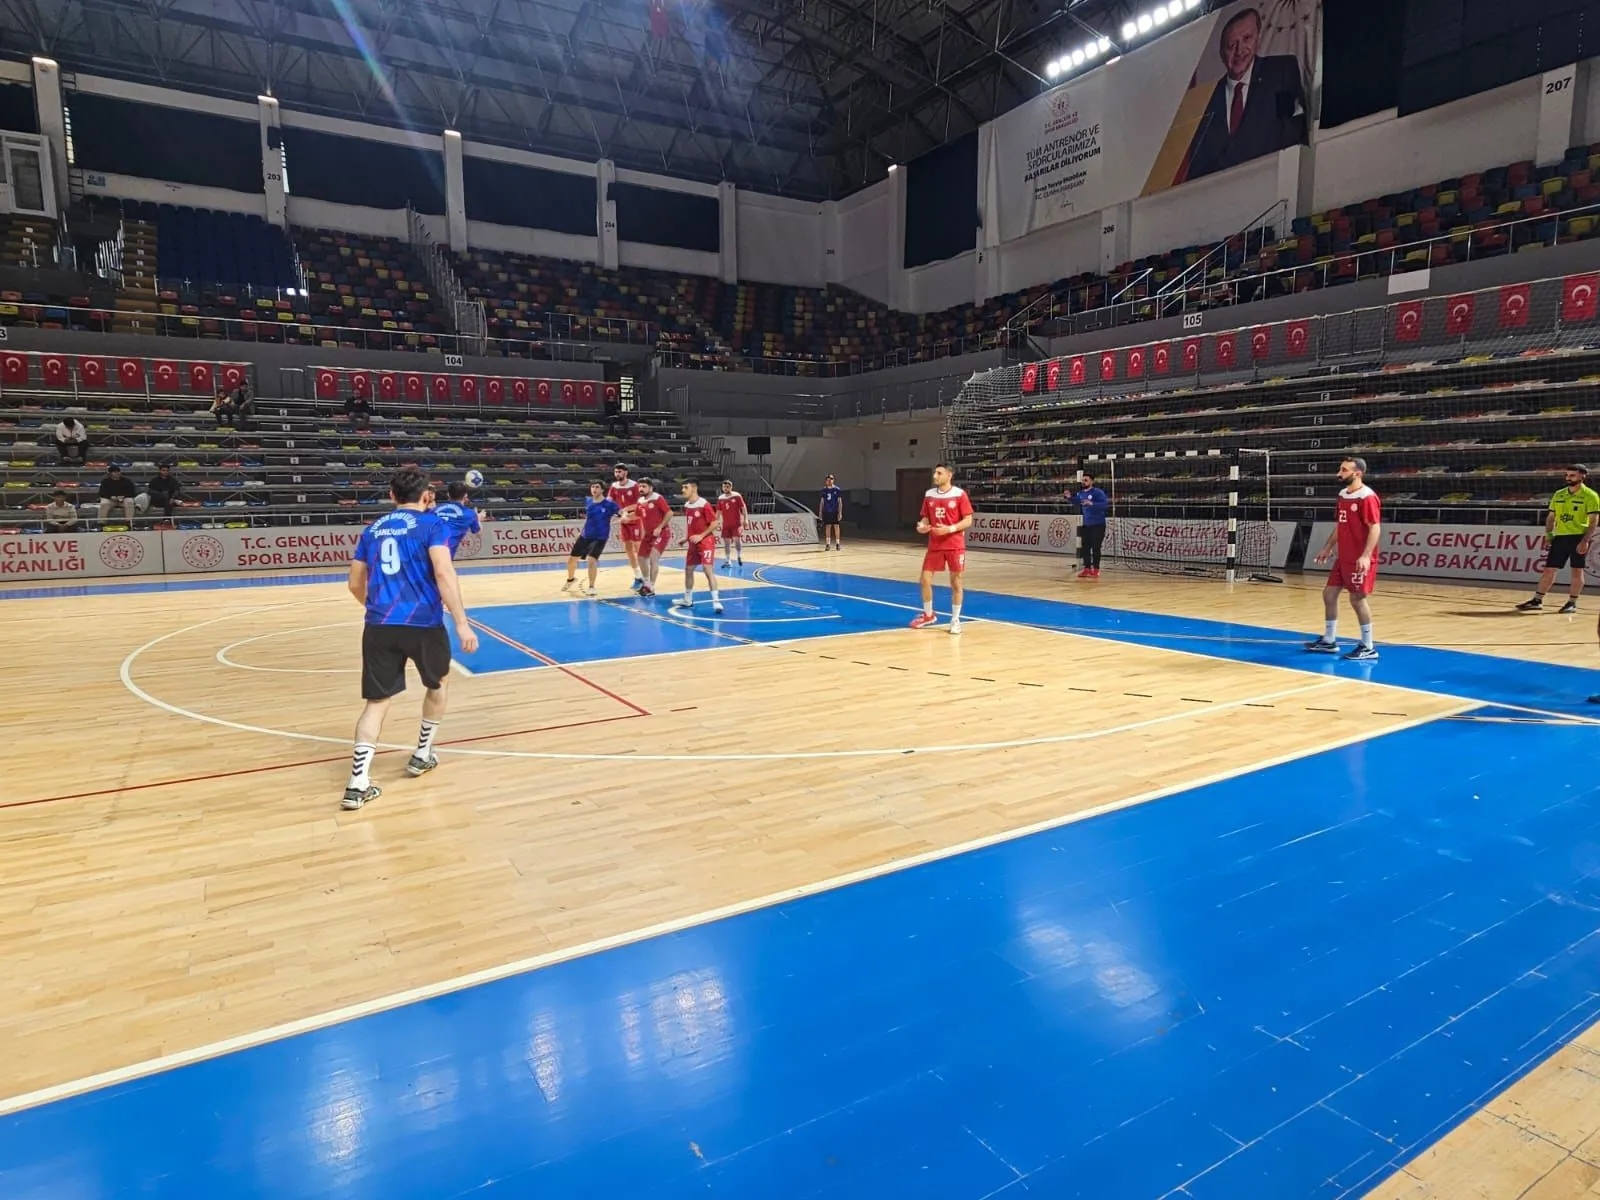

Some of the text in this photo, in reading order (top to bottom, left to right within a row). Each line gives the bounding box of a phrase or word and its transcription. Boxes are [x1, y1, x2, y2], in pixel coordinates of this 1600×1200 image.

[1545, 76, 1572, 95] 207
[1088, 123, 1101, 135] VE
[1027, 136, 1097, 171] SPORCULARIMIZA
[1184, 315, 1201, 327] 105
[445, 356, 463, 367] 104
[935, 507, 946, 518] 22
[761, 520, 774, 531] VE
[989, 517, 1027, 533] GENÇLİK
[1027, 519, 1040, 530] VE
[241, 532, 363, 550] T.C. GENÇLİK V
[494, 530, 518, 540] T.C.
[520, 526, 575, 541] GENÇLİK
[740, 533, 780, 544] KANLIĞI
[968, 532, 1040, 546] SPOR BAKANLIĞI
[0, 538, 79, 558] ÇLİK VE
[492, 542, 575, 555] SPOR BAKAN
[1388, 531, 1421, 546] T.C.
[1426, 531, 1521, 553] GENÇLİK
[238, 550, 354, 566] SPOR BAKANL
[381, 537, 401, 575] 9
[1377, 551, 1549, 573] SPOR BAKANLIĞ
[0, 555, 86, 574] KANLIĞI
[1351, 572, 1364, 585] 23
